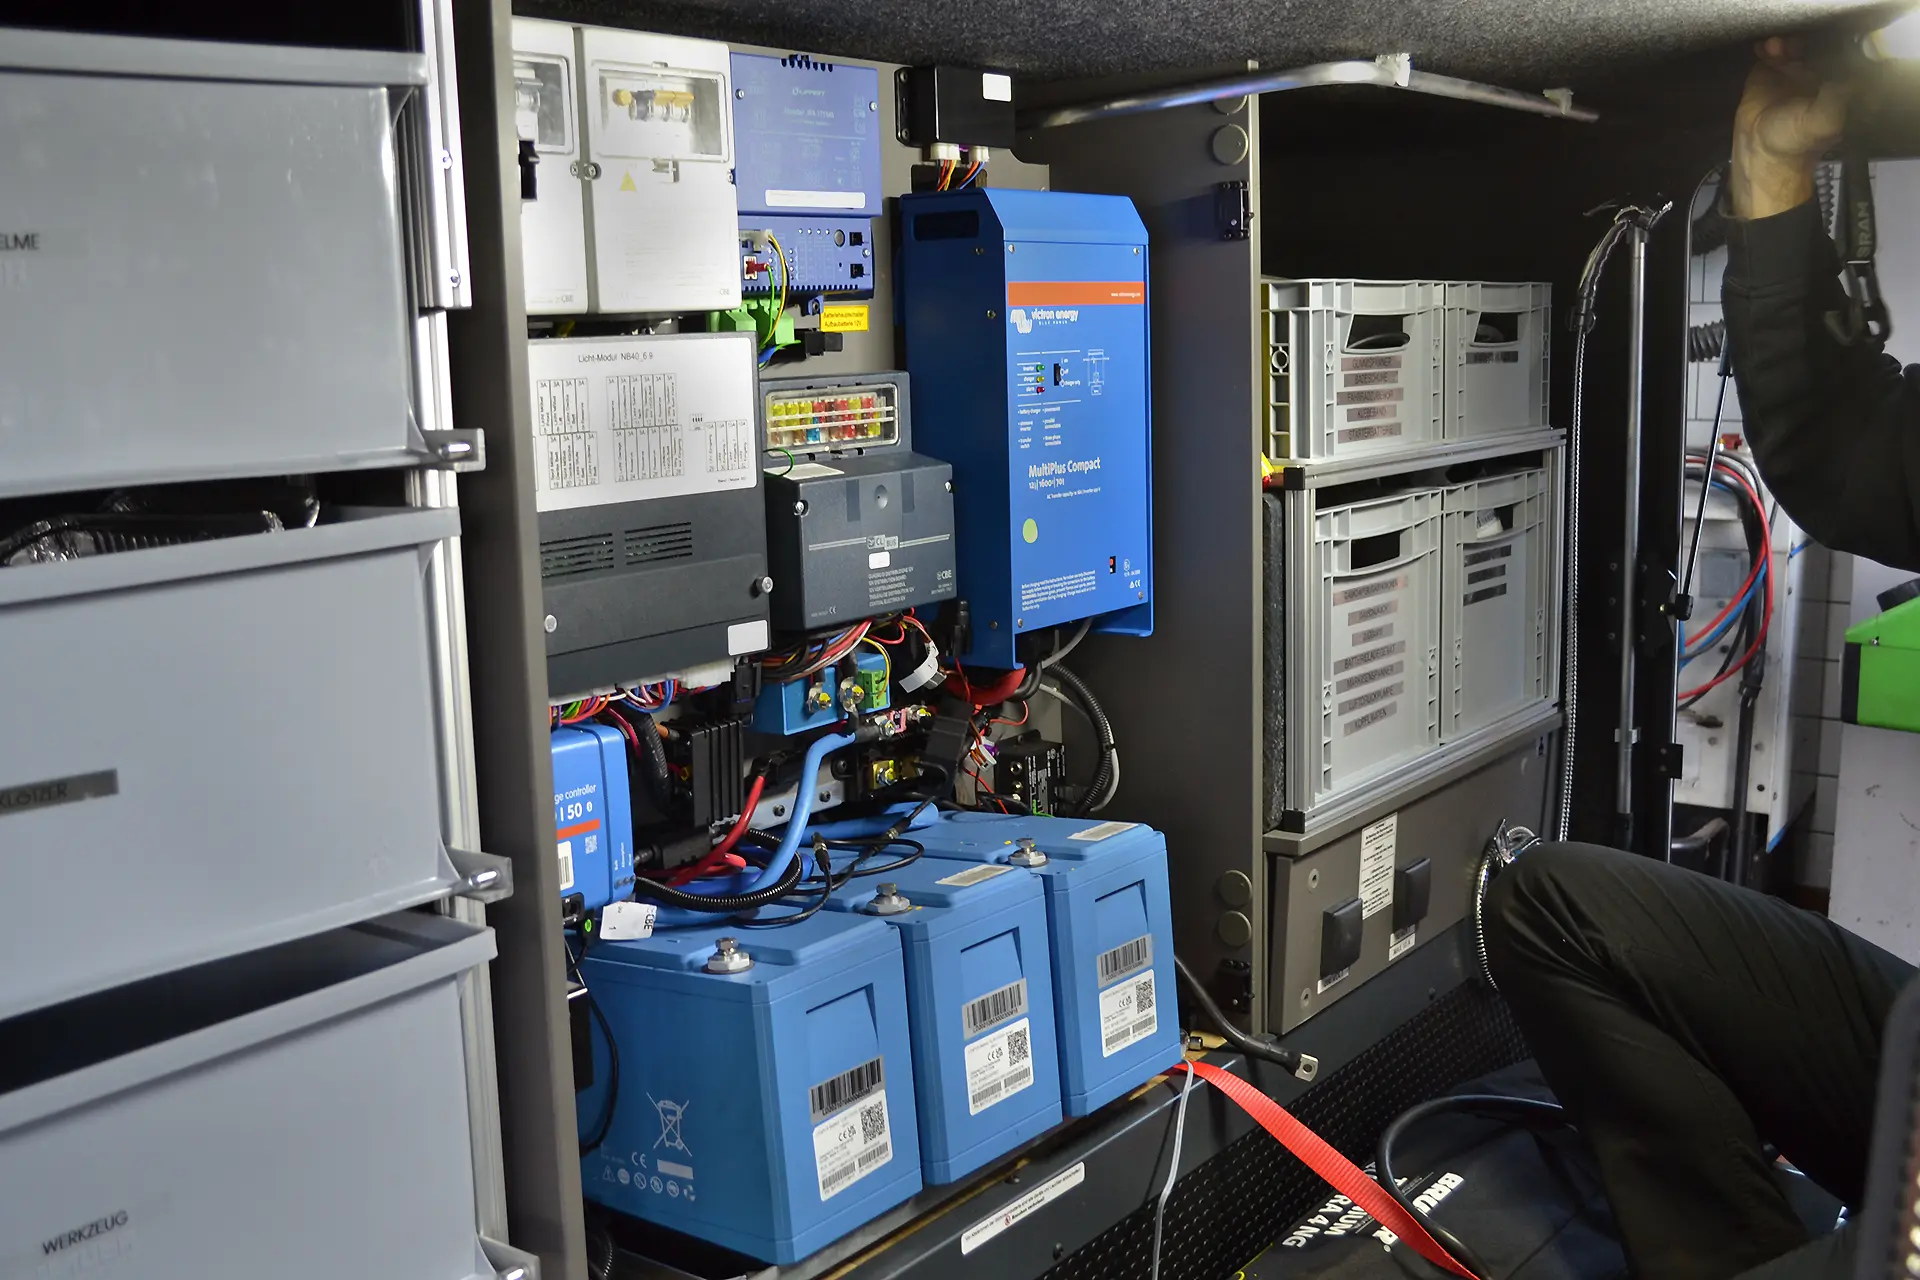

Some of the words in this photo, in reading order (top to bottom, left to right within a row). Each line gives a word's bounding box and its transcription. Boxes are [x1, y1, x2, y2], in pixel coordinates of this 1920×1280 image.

[1856, 201, 1873, 258] SRAM
[1031, 308, 1055, 320] victron
[1056, 310, 1079, 322] energy
[578, 353, 618, 363] Licht-Modul
[1028, 461, 1067, 478] MultiPlus
[1067, 457, 1101, 474] Compact
[565, 784, 597, 800] controller
[567, 802, 583, 820] 50
[643, 913, 654, 930] CBE
[42, 1209, 129, 1255] WERKZEUG
[1281, 1225, 1321, 1249] NG
